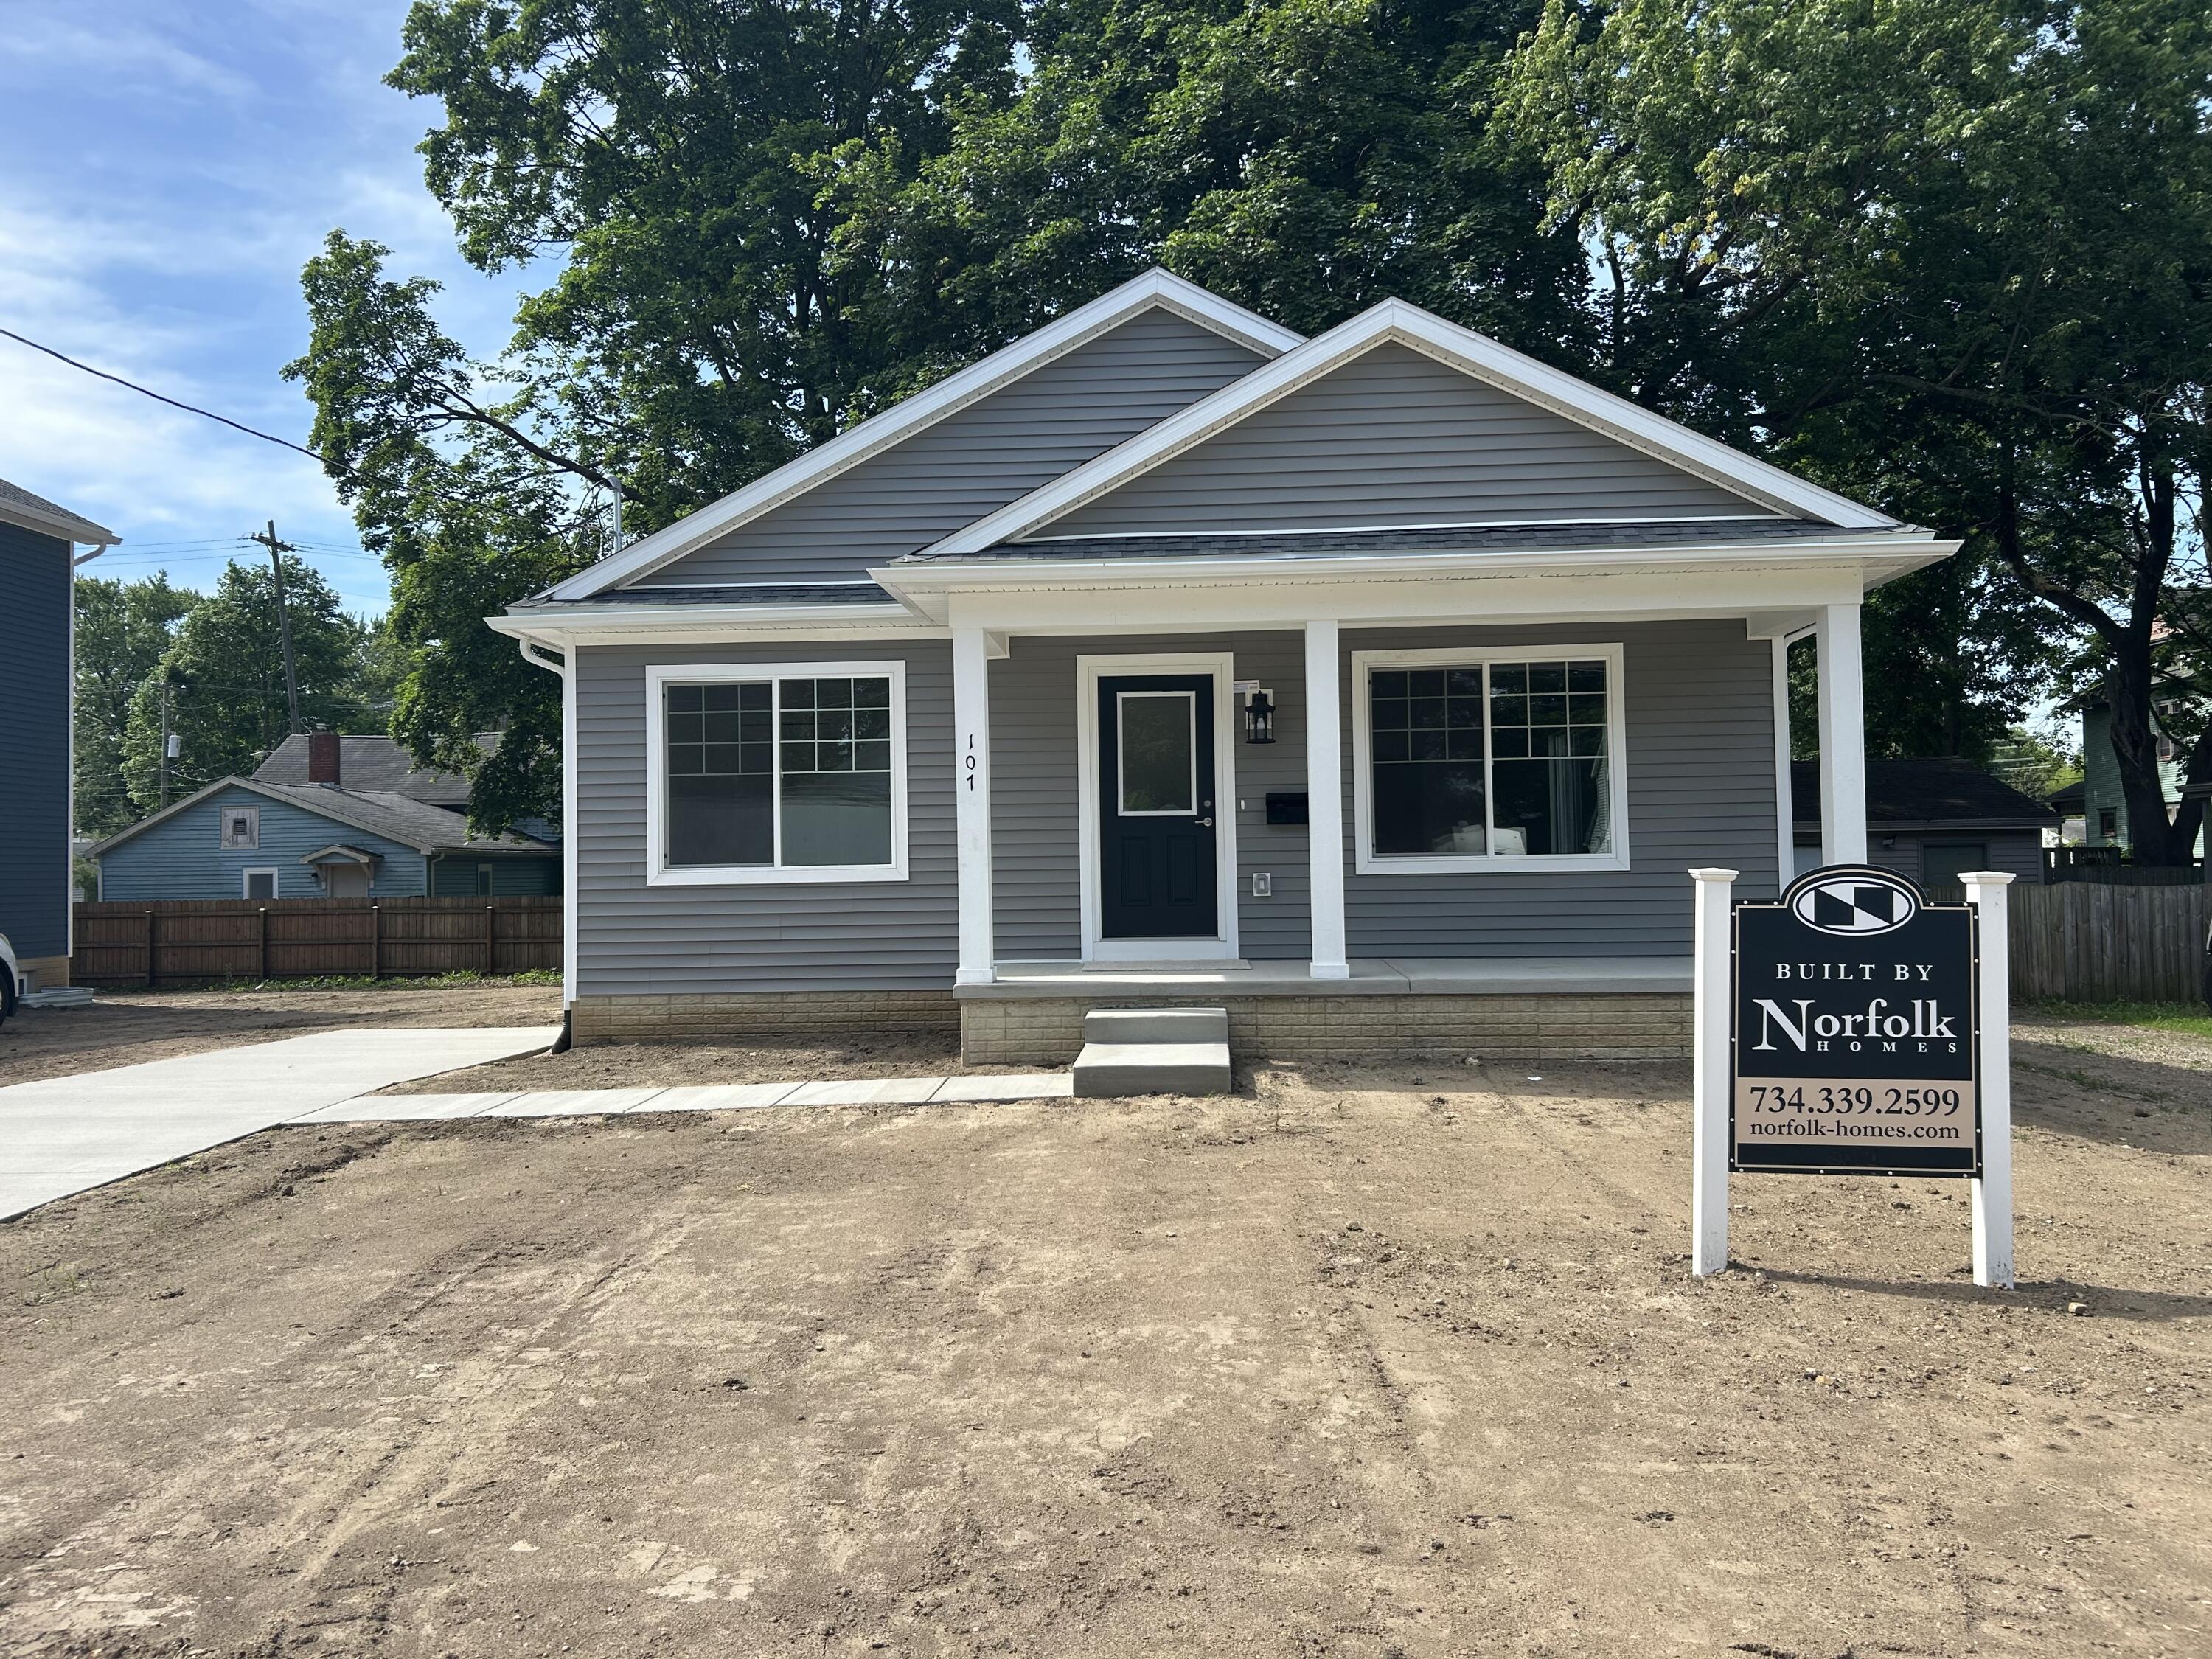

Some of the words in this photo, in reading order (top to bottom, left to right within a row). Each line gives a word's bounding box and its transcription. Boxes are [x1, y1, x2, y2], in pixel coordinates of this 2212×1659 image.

[1775, 963, 1875, 981] BUILT
[1894, 964, 1933, 981] BY
[1751, 998, 1957, 1051] Norfolk
[1817, 1040, 1957, 1053] HOMES
[1750, 1086, 1960, 1116] 734.339.2599
[1750, 1119, 1960, 1139] norfolk-homes.com
